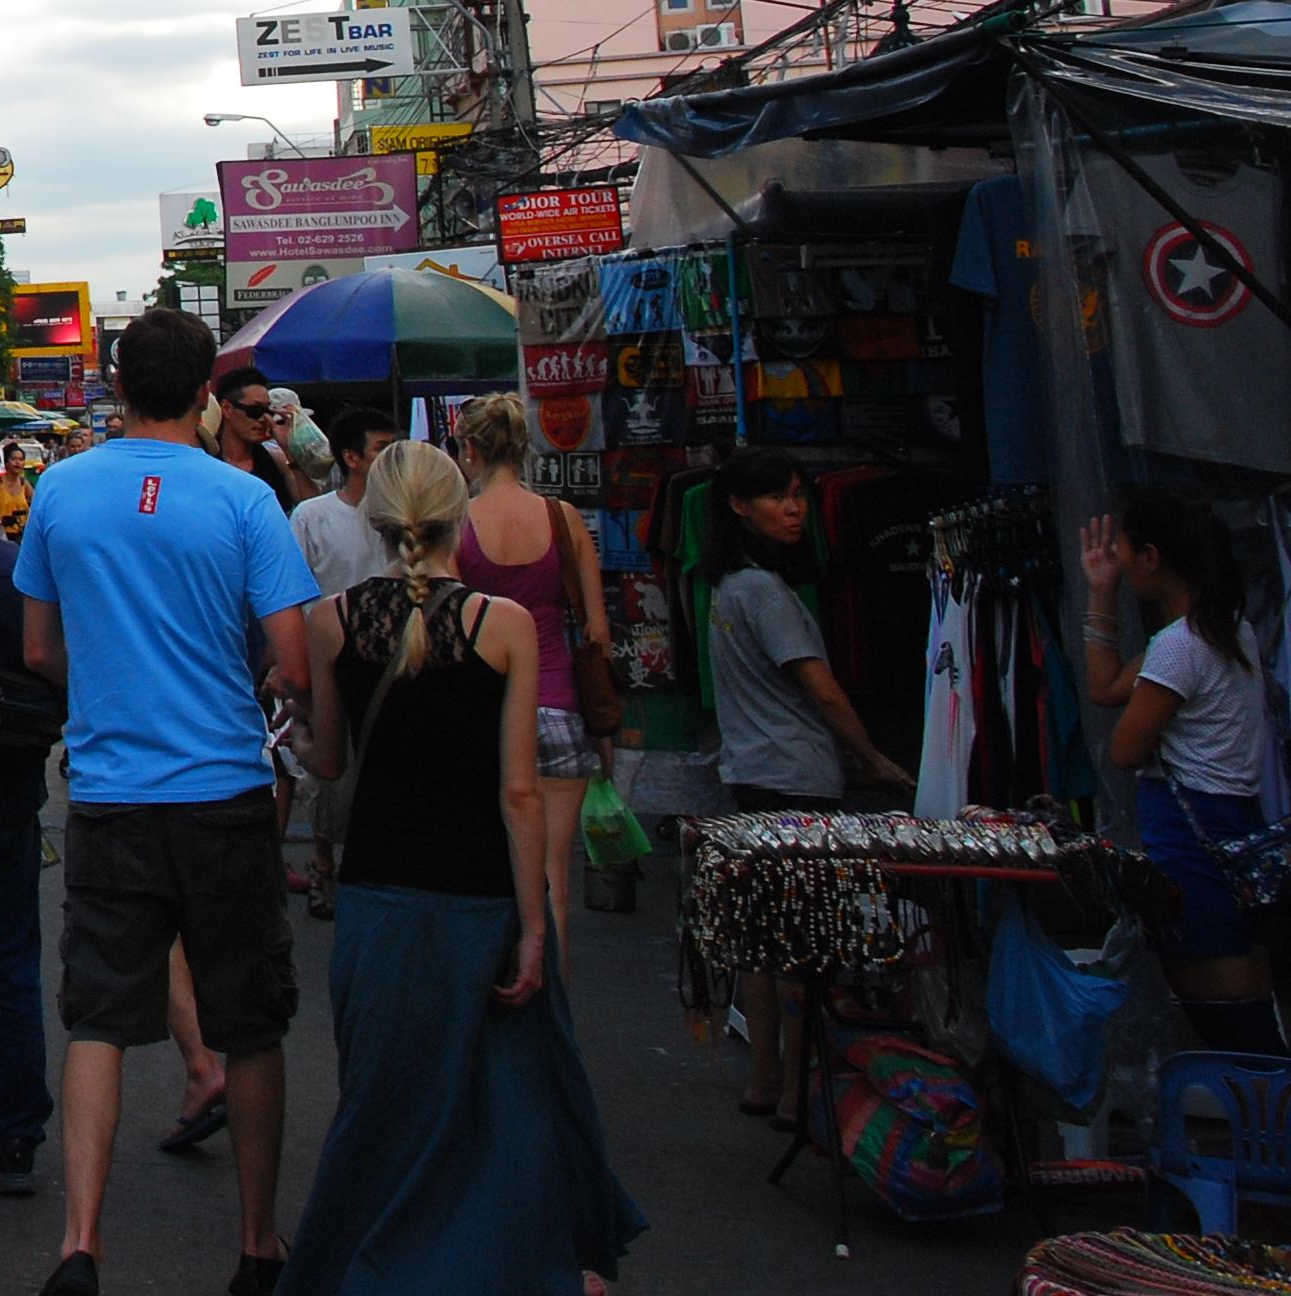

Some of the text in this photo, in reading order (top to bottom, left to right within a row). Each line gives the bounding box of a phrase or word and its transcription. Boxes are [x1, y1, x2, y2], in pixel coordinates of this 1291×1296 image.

[256, 16, 393, 46] ZEST BAR
[257, 51, 280, 59] ZEST
[363, 43, 395, 52] MUSIC
[241, 167, 377, 210] Sawasdee
[519, 191, 614, 210] DIOR TOUR
[233, 212, 401, 230] SAWASDEE BANGLUMPOO INN
[500, 209, 561, 222] WORLD-WIDE
[563, 207, 578, 215] AIR
[581, 204, 617, 214] TICKETS
[527, 230, 620, 248] OVERSEA CALL
[542, 244, 604, 259] INTERNET
